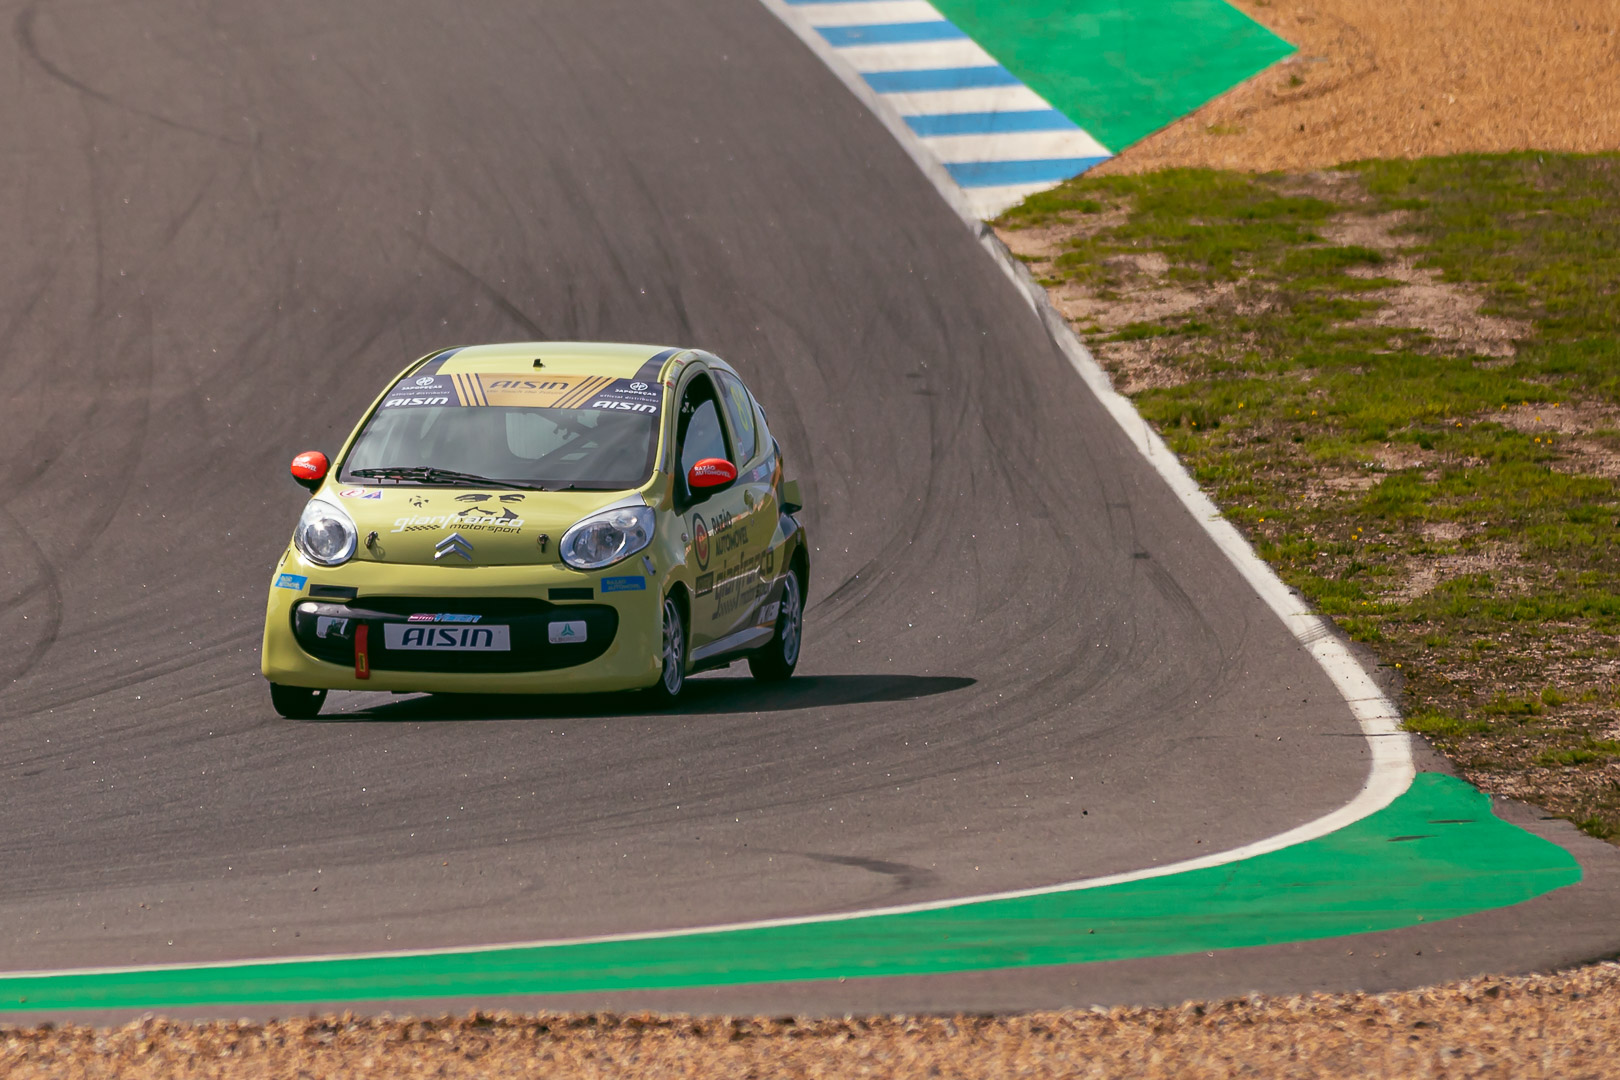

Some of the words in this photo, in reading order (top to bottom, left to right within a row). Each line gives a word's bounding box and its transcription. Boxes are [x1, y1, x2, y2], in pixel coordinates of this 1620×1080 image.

[490, 380, 569, 390] AISIN
[384, 397, 449, 408] AISIN
[592, 400, 657, 414] AISIN
[390, 513, 525, 534] gianfranco
[449, 523, 522, 535] motorsport
[401, 627, 494, 647] AISIN
